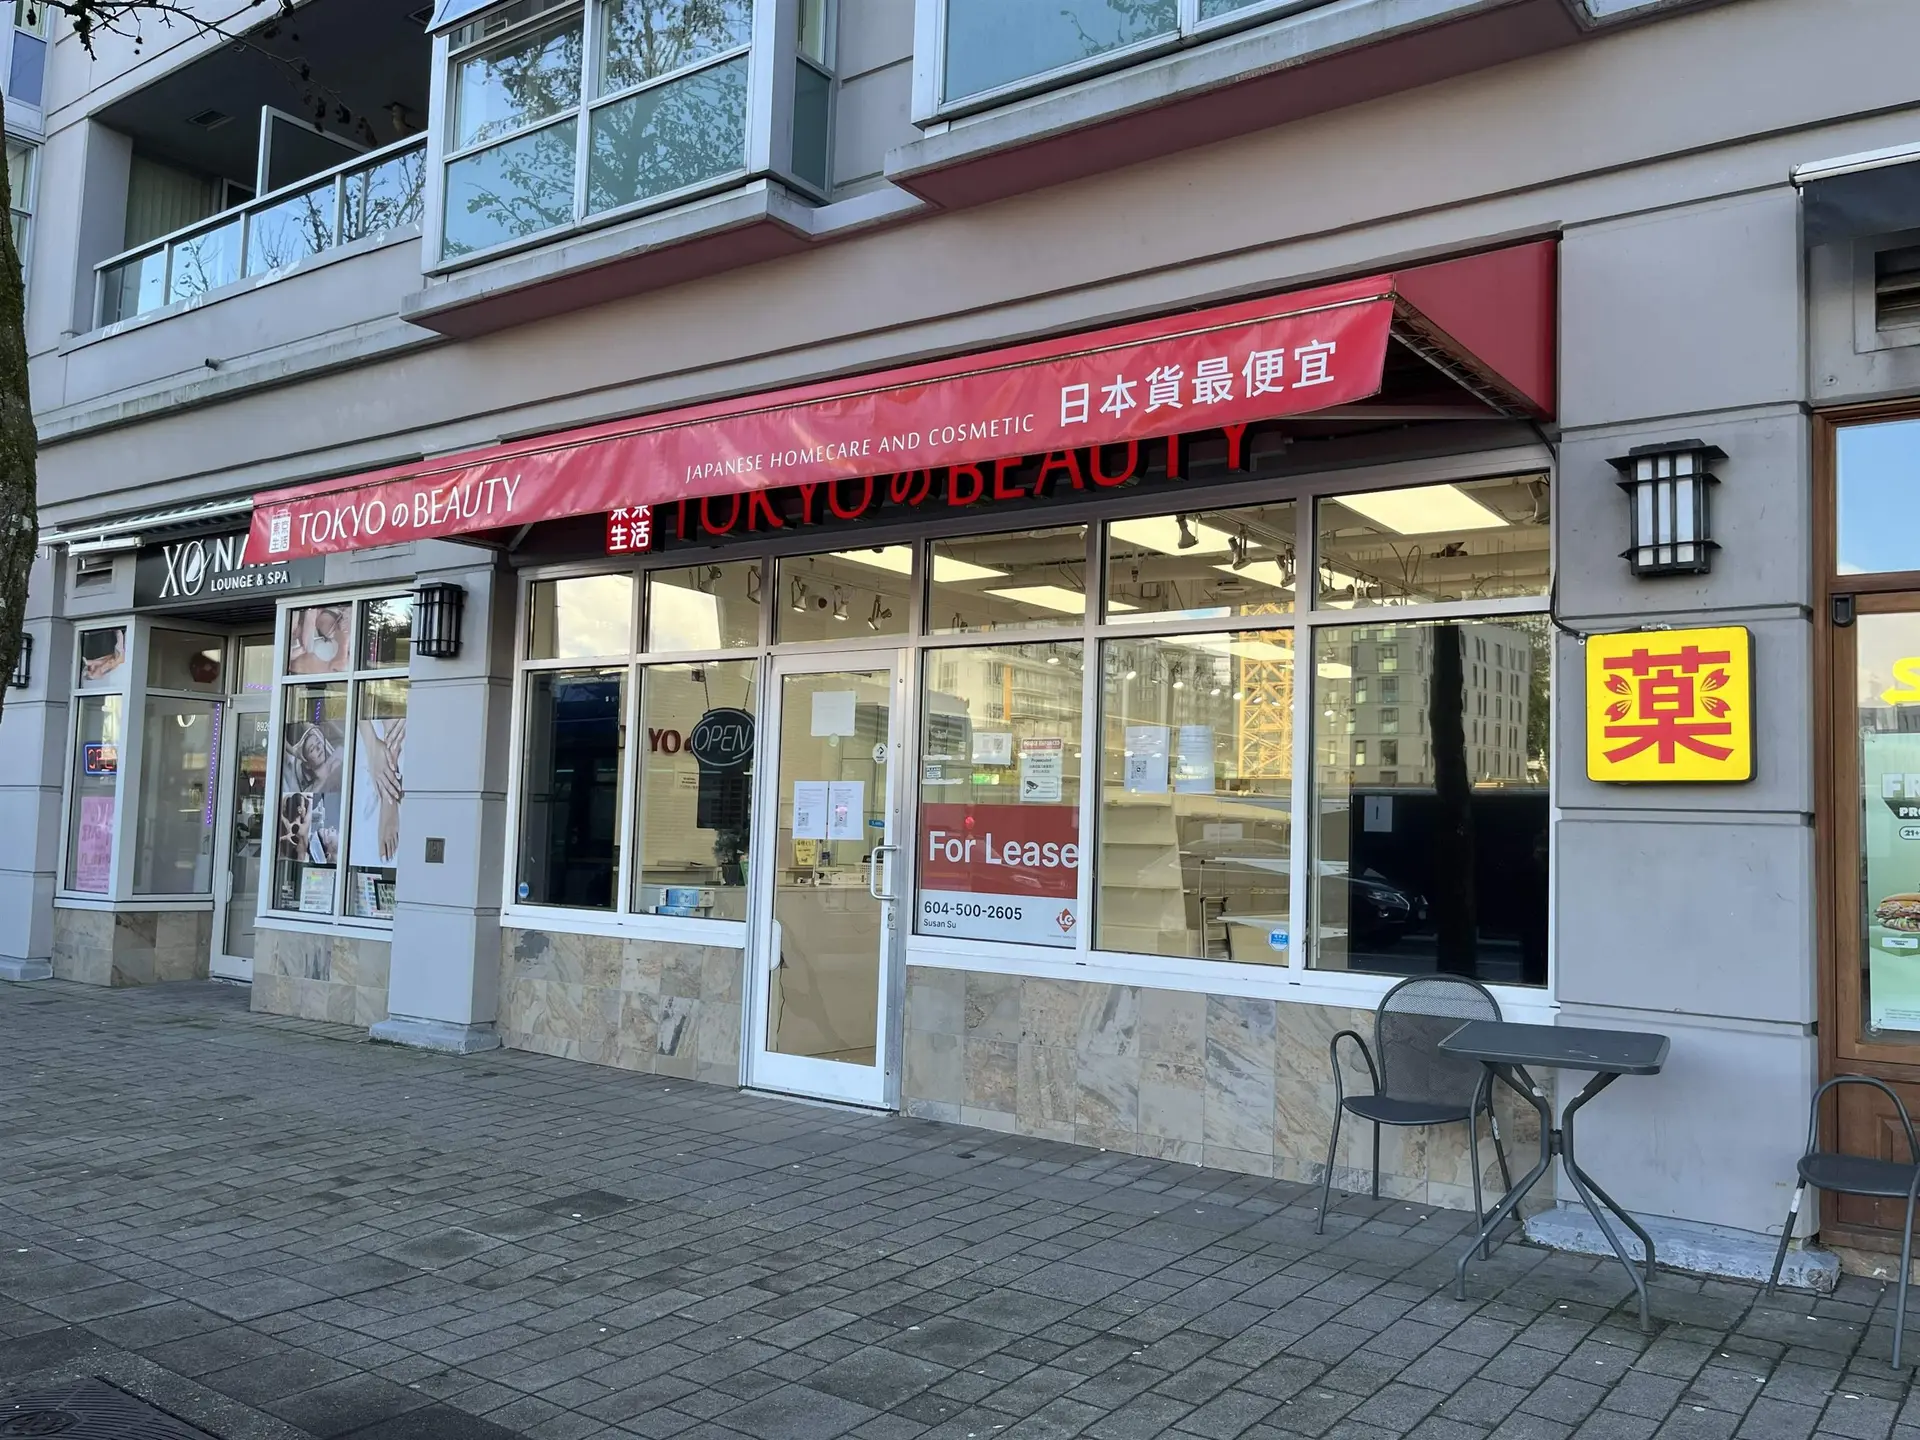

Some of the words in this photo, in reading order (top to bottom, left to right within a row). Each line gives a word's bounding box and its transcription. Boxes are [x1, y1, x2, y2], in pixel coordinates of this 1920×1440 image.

[1060, 339, 1337, 427] 日本貨最便宜
[685, 454, 763, 484] JAPANESE
[770, 438, 871, 468] HOMECARE
[878, 431, 920, 455] AND
[928, 413, 1035, 446] COSMETIC
[299, 500, 386, 545] TOKYO
[413, 474, 522, 528] BEAUTY
[609, 521, 650, 551] 生活
[211, 574, 253, 592] LOUNGE
[256, 572, 264, 586] &
[268, 571, 289, 585] SPA
[695, 725, 750, 752] OPEN
[929, 830, 976, 863] For
[985, 832, 1079, 868] Lease
[923, 918, 946, 928] Susan
[947, 920, 957, 929] Su
[924, 901, 1022, 920] 604-500-2605
